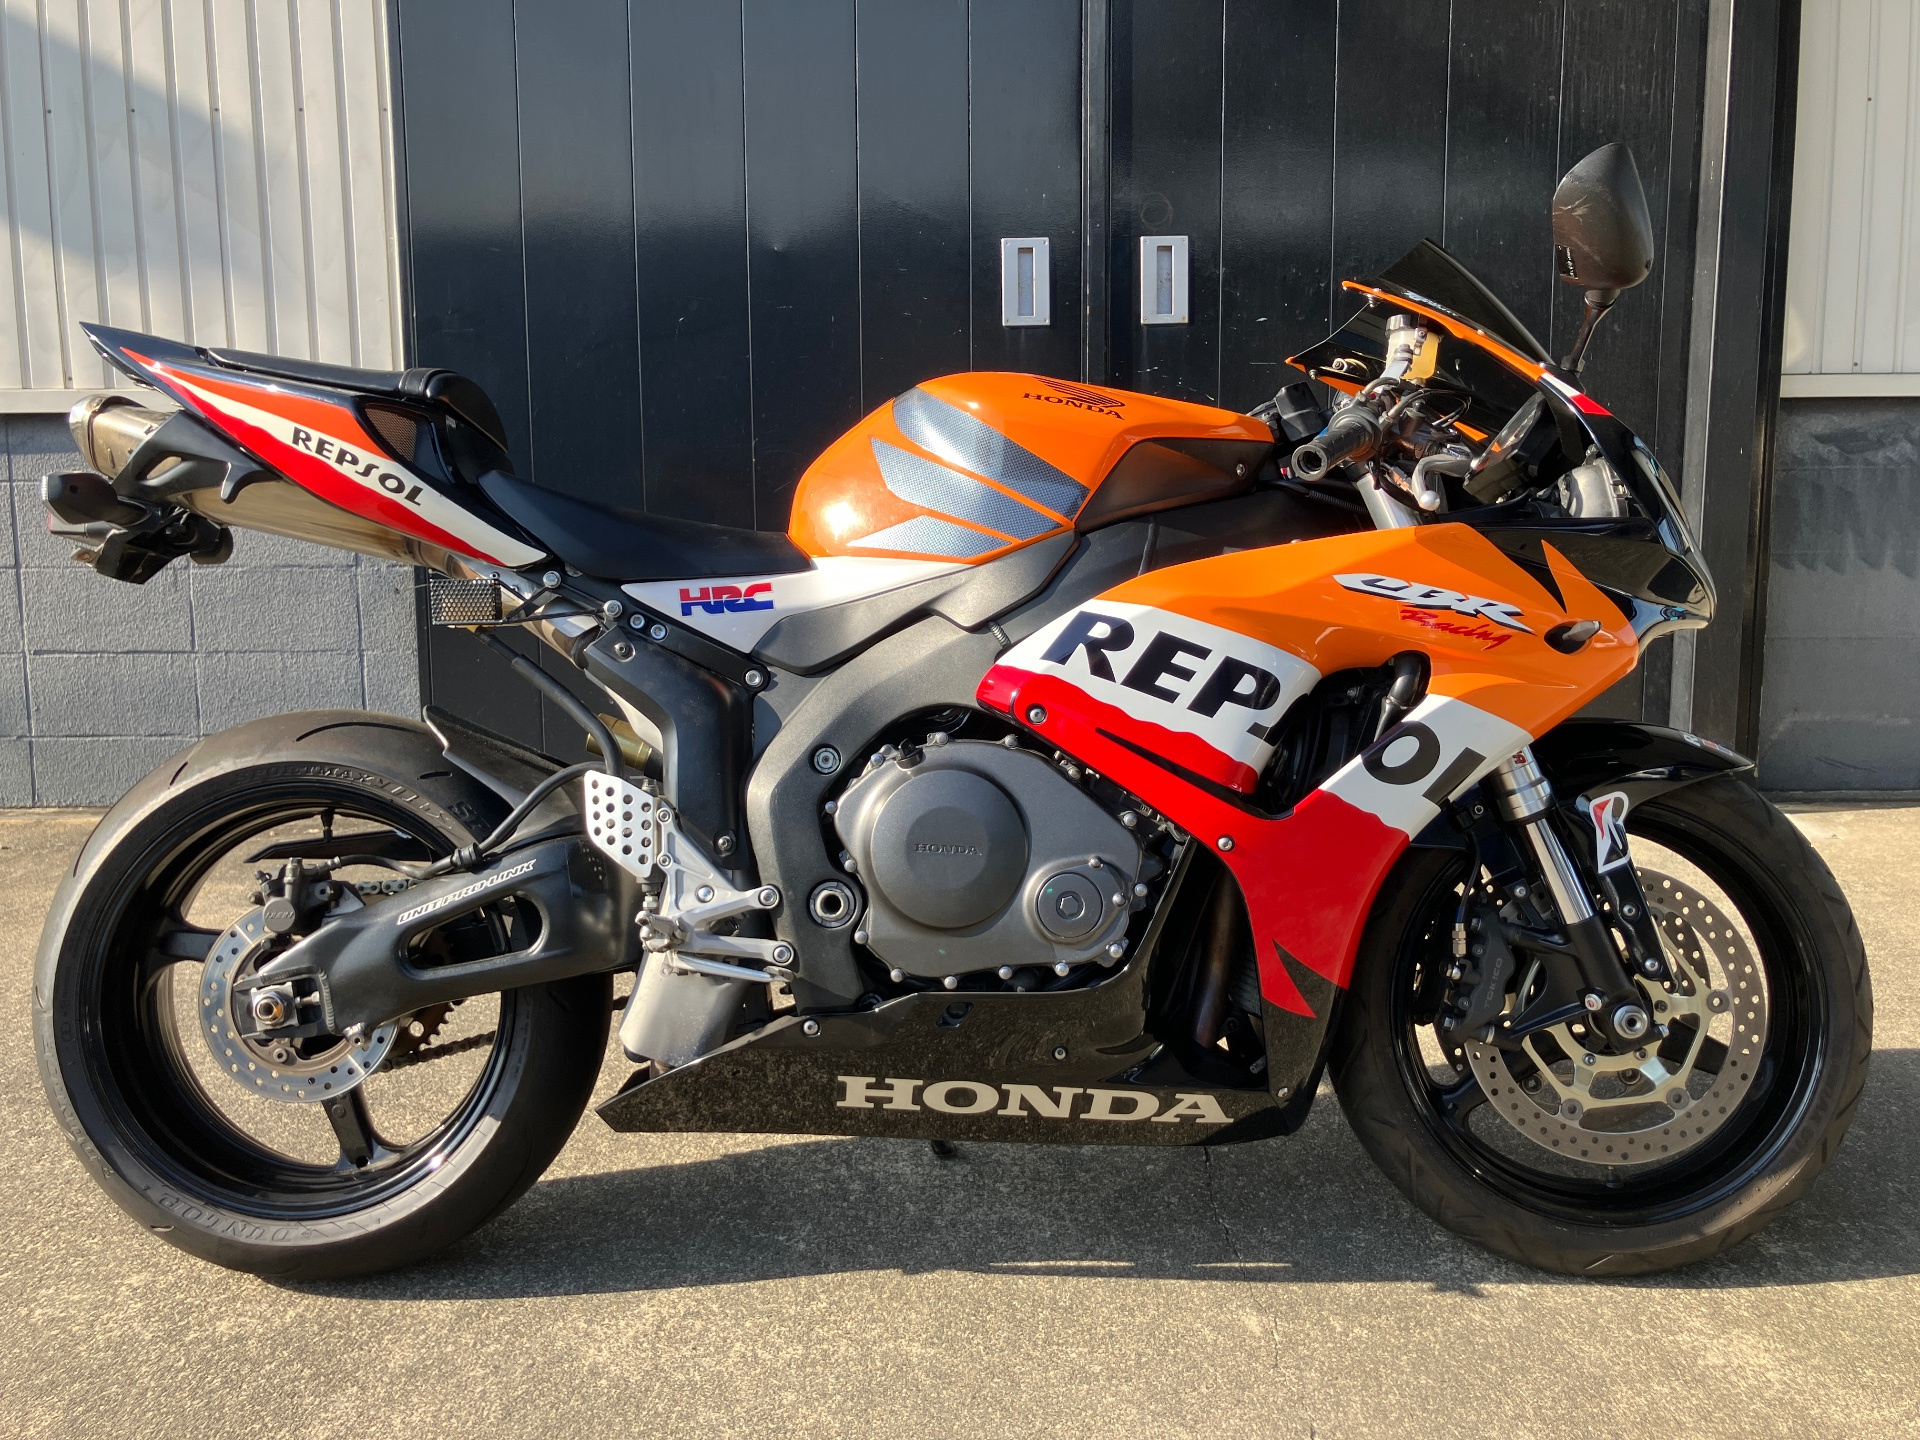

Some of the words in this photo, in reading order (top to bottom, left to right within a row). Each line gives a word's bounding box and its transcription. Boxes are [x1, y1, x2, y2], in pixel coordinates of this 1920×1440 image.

[1021, 392, 1125, 420] HONDA
[291, 426, 424, 507] REPSOL
[679, 582, 775, 617] HRC
[1332, 572, 1537, 636] CBR
[1399, 608, 1513, 651] Racing
[914, 843, 982, 856] HONDA
[396, 896, 442, 926] UNIT
[836, 1075, 1234, 1124] HONDA
[158, 1192, 299, 1243] DUNLOP
